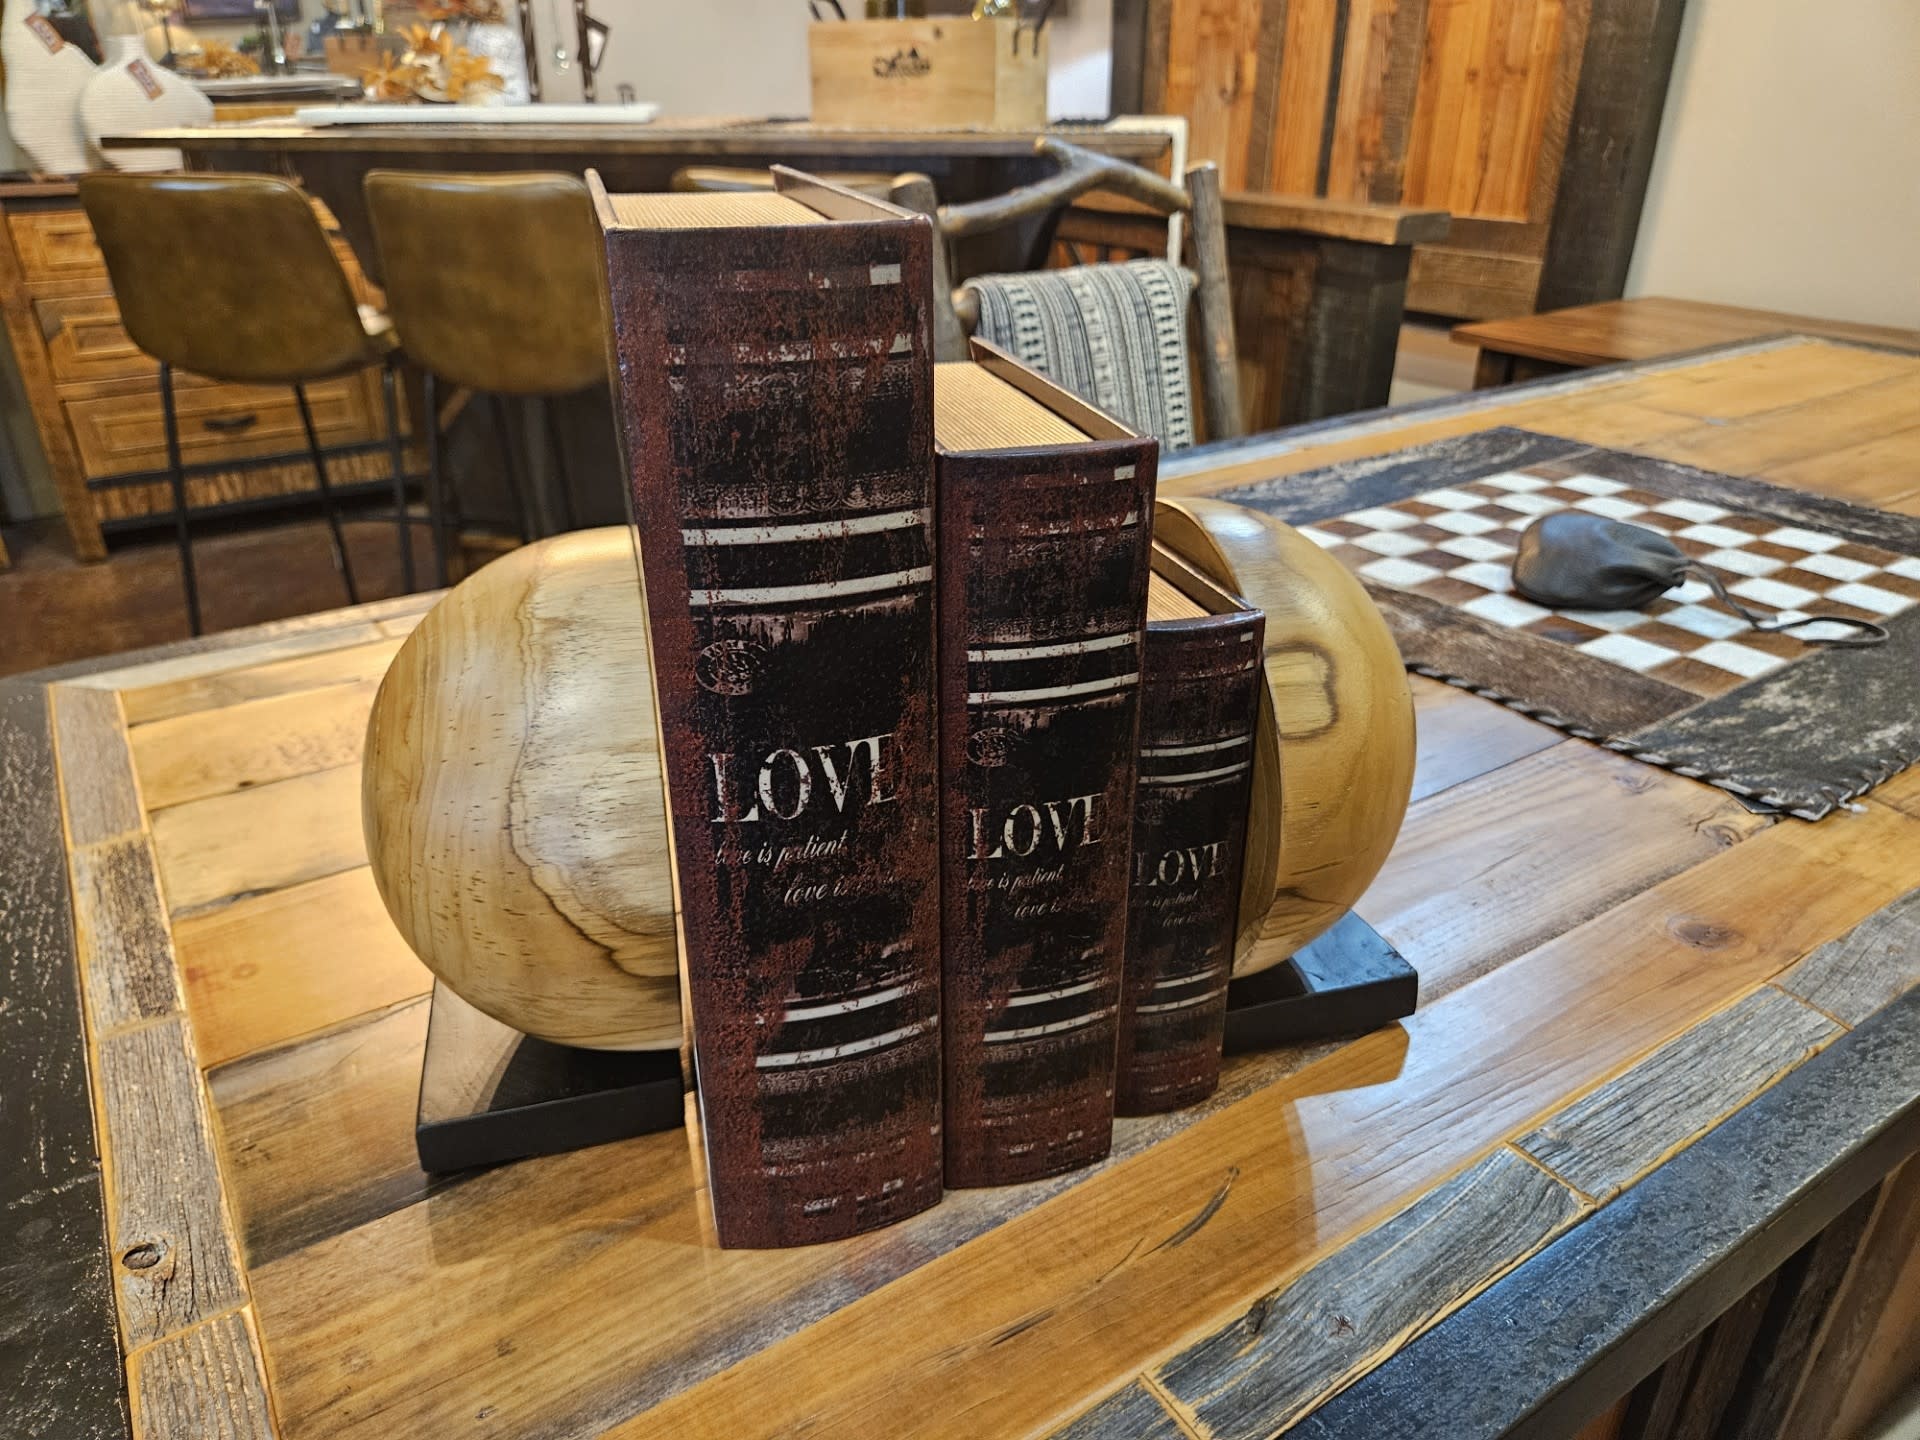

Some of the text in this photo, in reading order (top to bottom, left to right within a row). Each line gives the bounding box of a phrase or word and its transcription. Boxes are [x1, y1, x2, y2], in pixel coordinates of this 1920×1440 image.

[707, 734, 899, 822] LOVE
[967, 793, 1105, 859] LOVE
[757, 842, 773, 867] is
[1133, 840, 1226, 887] LOVE
